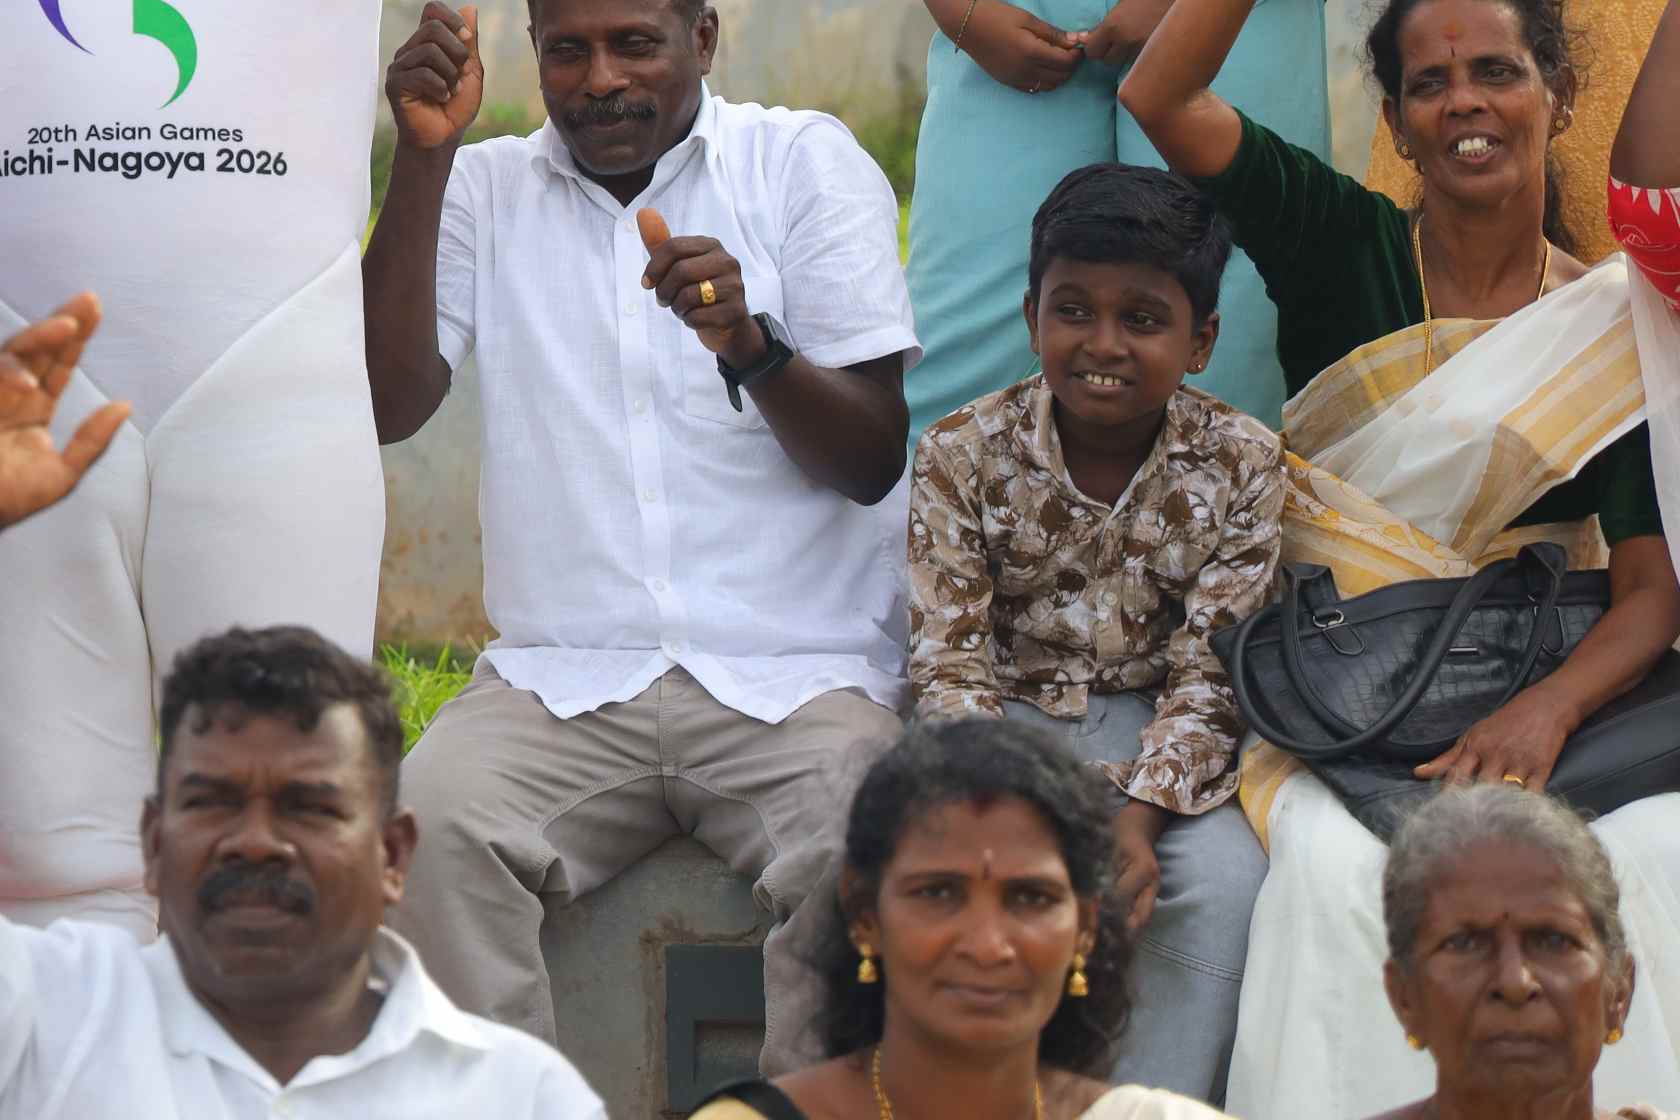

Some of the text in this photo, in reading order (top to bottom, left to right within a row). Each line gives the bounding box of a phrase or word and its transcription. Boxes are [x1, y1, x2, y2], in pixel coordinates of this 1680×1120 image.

[27, 122, 244, 144] 20th Asian Games
[216, 148, 288, 176] 2026
